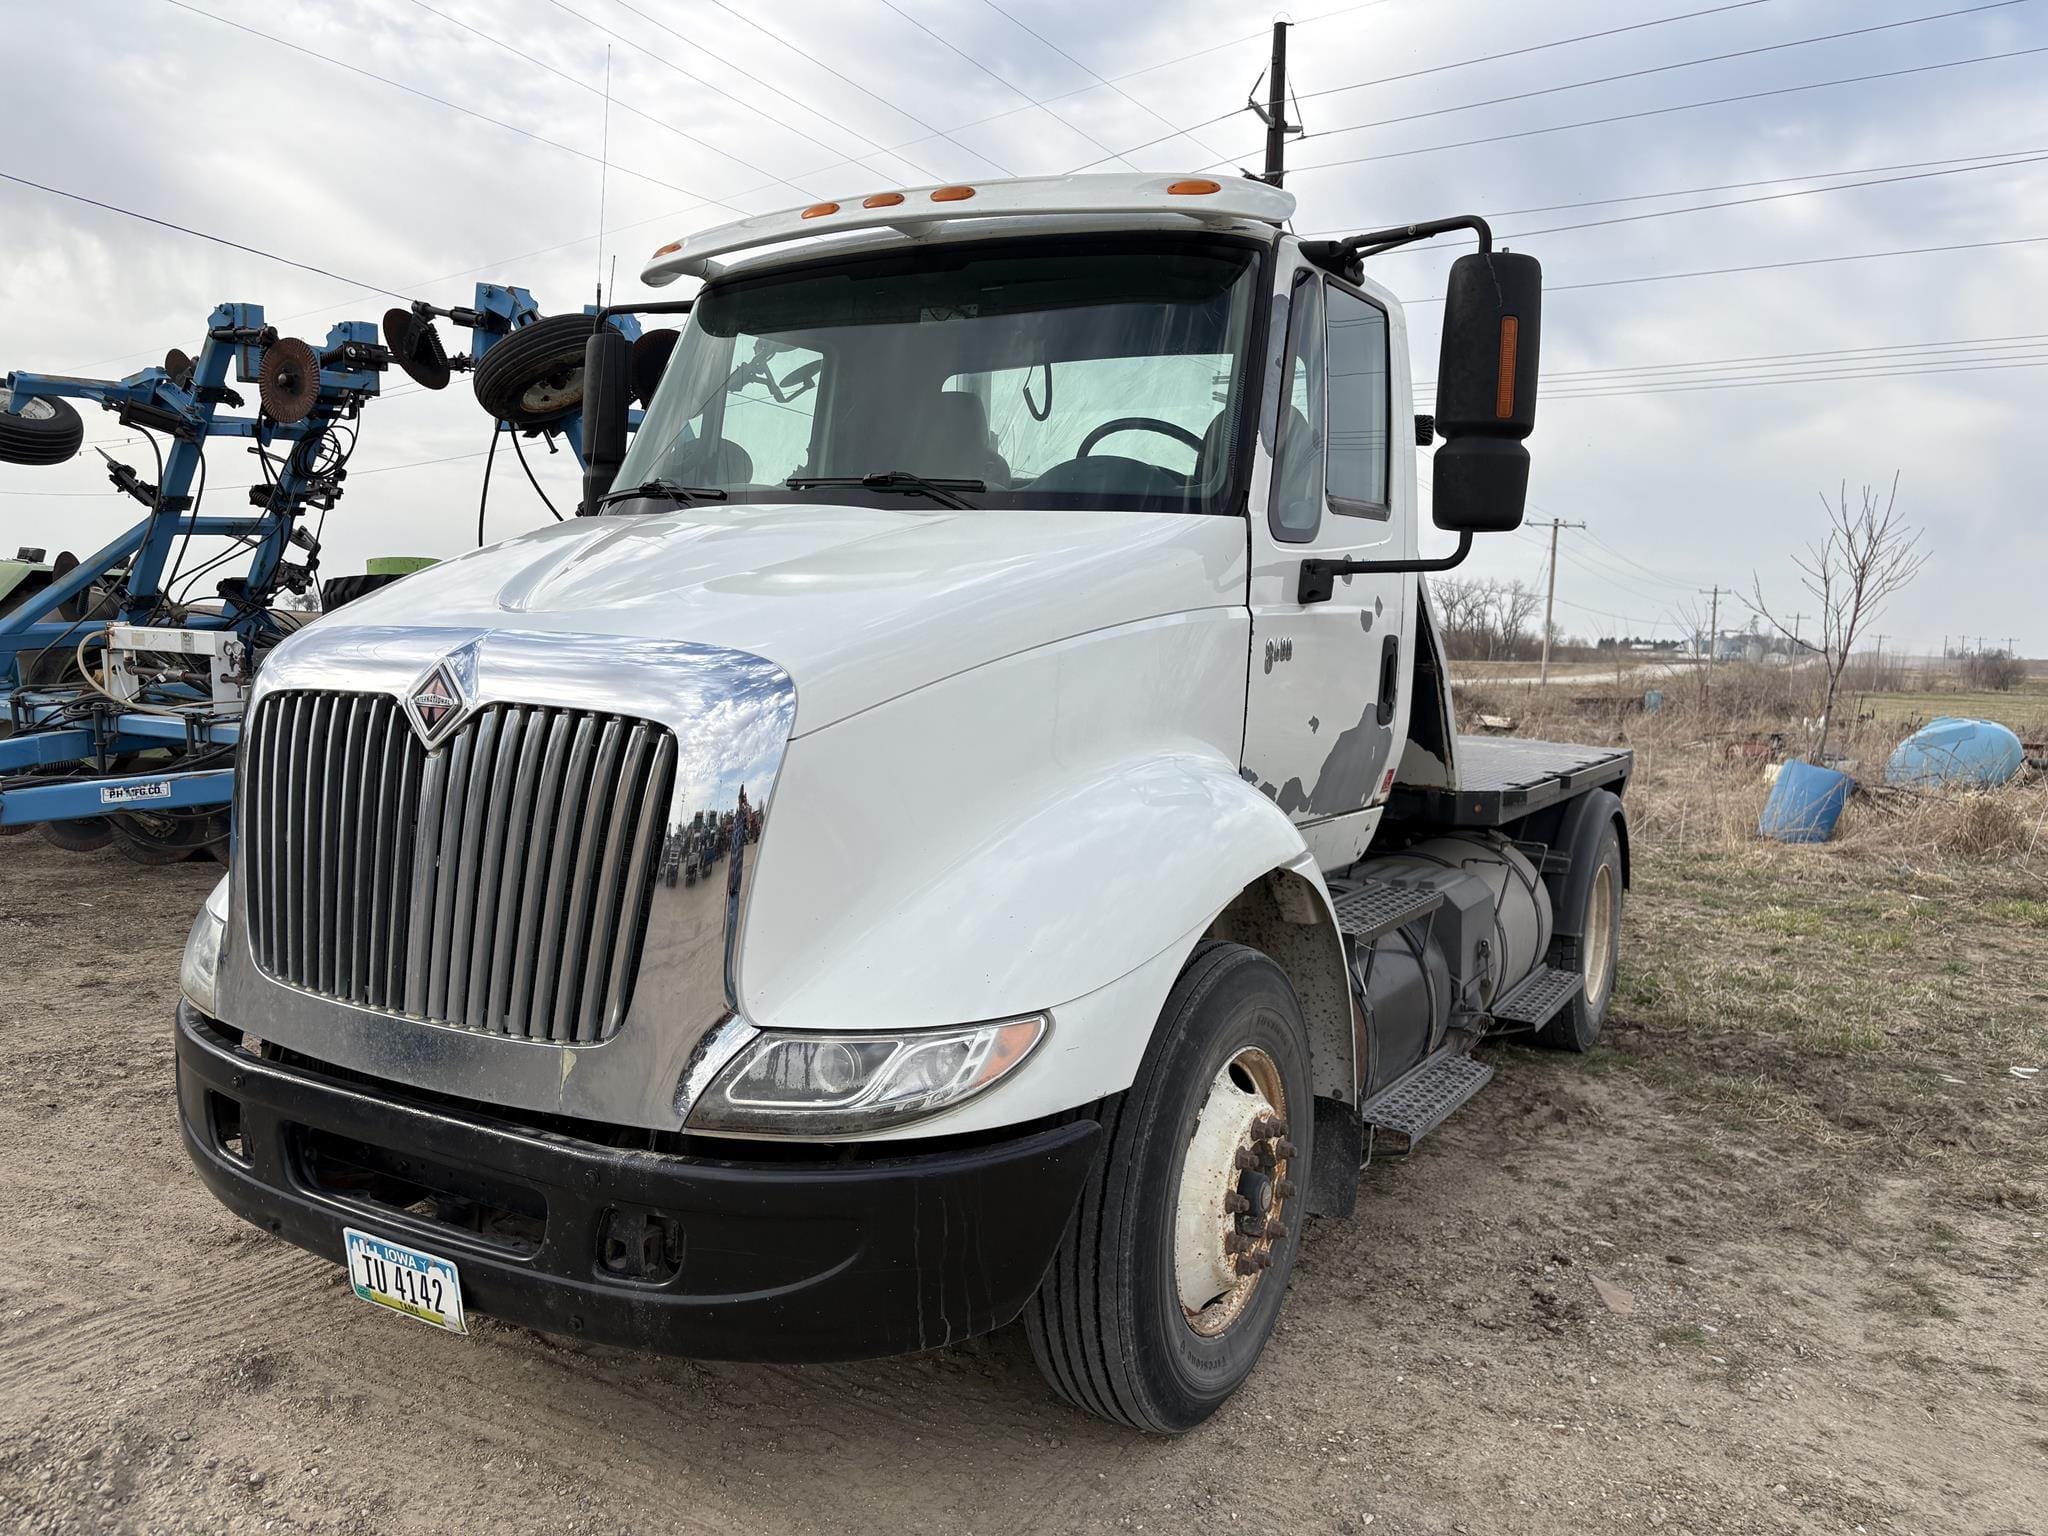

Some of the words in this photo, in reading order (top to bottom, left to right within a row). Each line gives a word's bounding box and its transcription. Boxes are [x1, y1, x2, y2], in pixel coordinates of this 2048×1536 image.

[385, 1249, 417, 1269] IOWA
[362, 1254, 387, 1294] IU
[395, 1266, 445, 1314] 4142
[399, 1301, 420, 1315] TAMA
